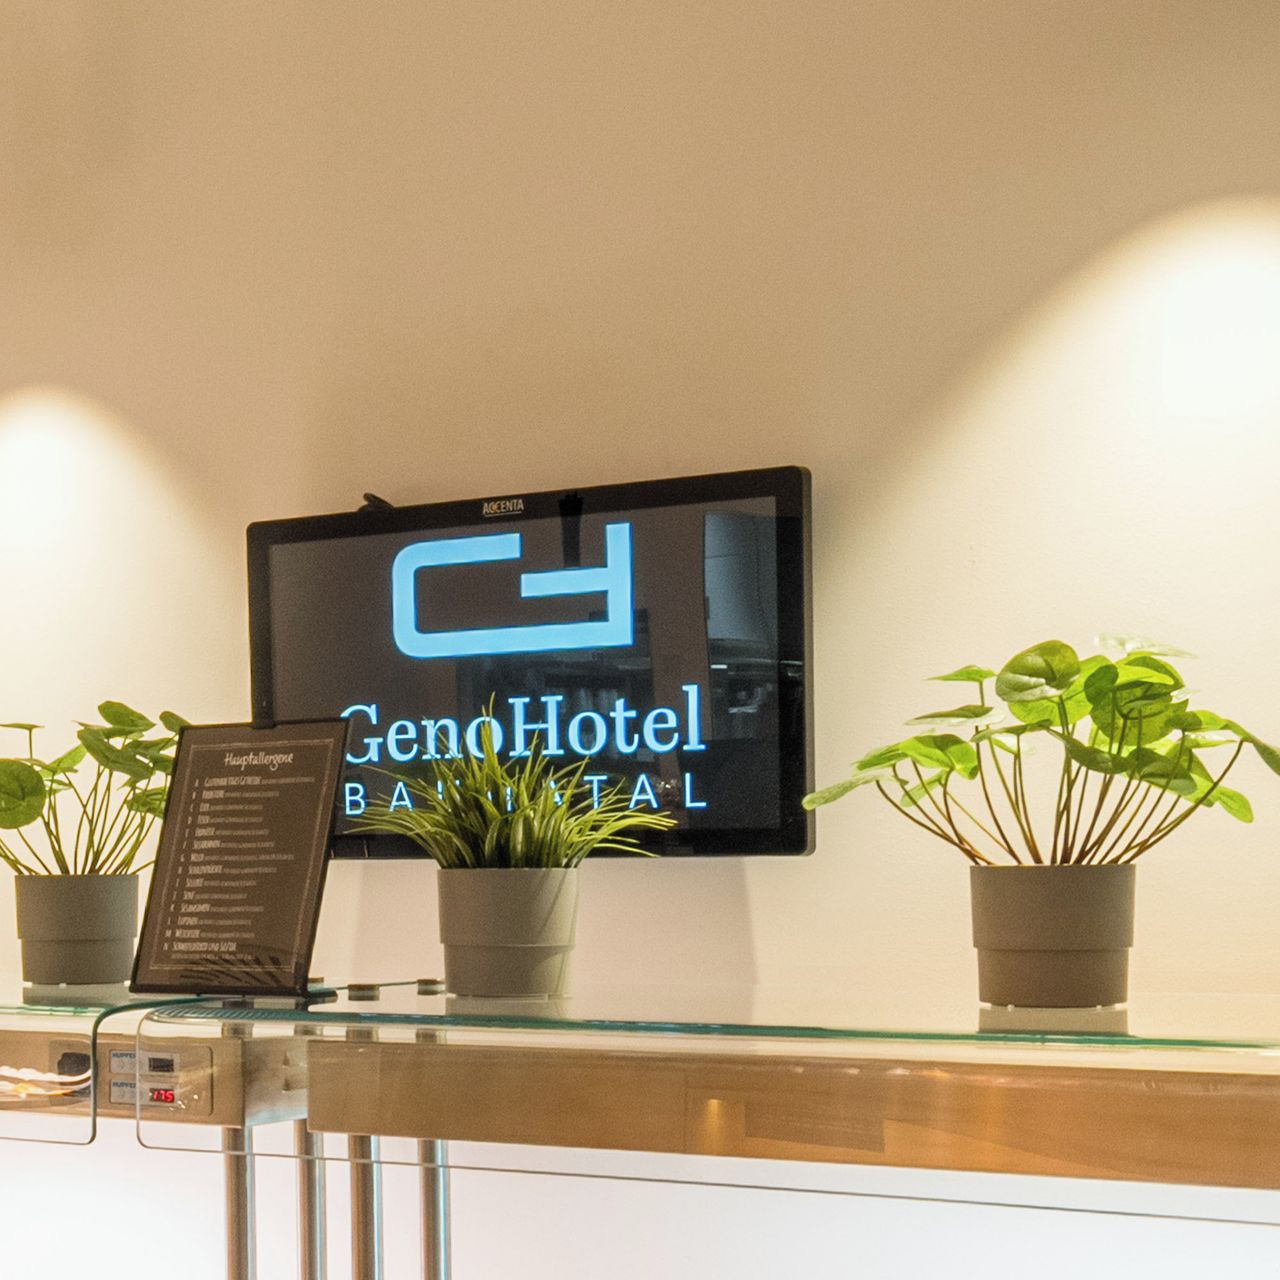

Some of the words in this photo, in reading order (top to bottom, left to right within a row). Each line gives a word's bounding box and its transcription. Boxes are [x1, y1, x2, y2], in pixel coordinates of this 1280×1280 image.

[483, 499, 524, 514] ACCENTA
[339, 684, 707, 764] GenoHotel
[224, 751, 294, 771] Hauptallergene
[344, 772, 708, 817] BATAL
